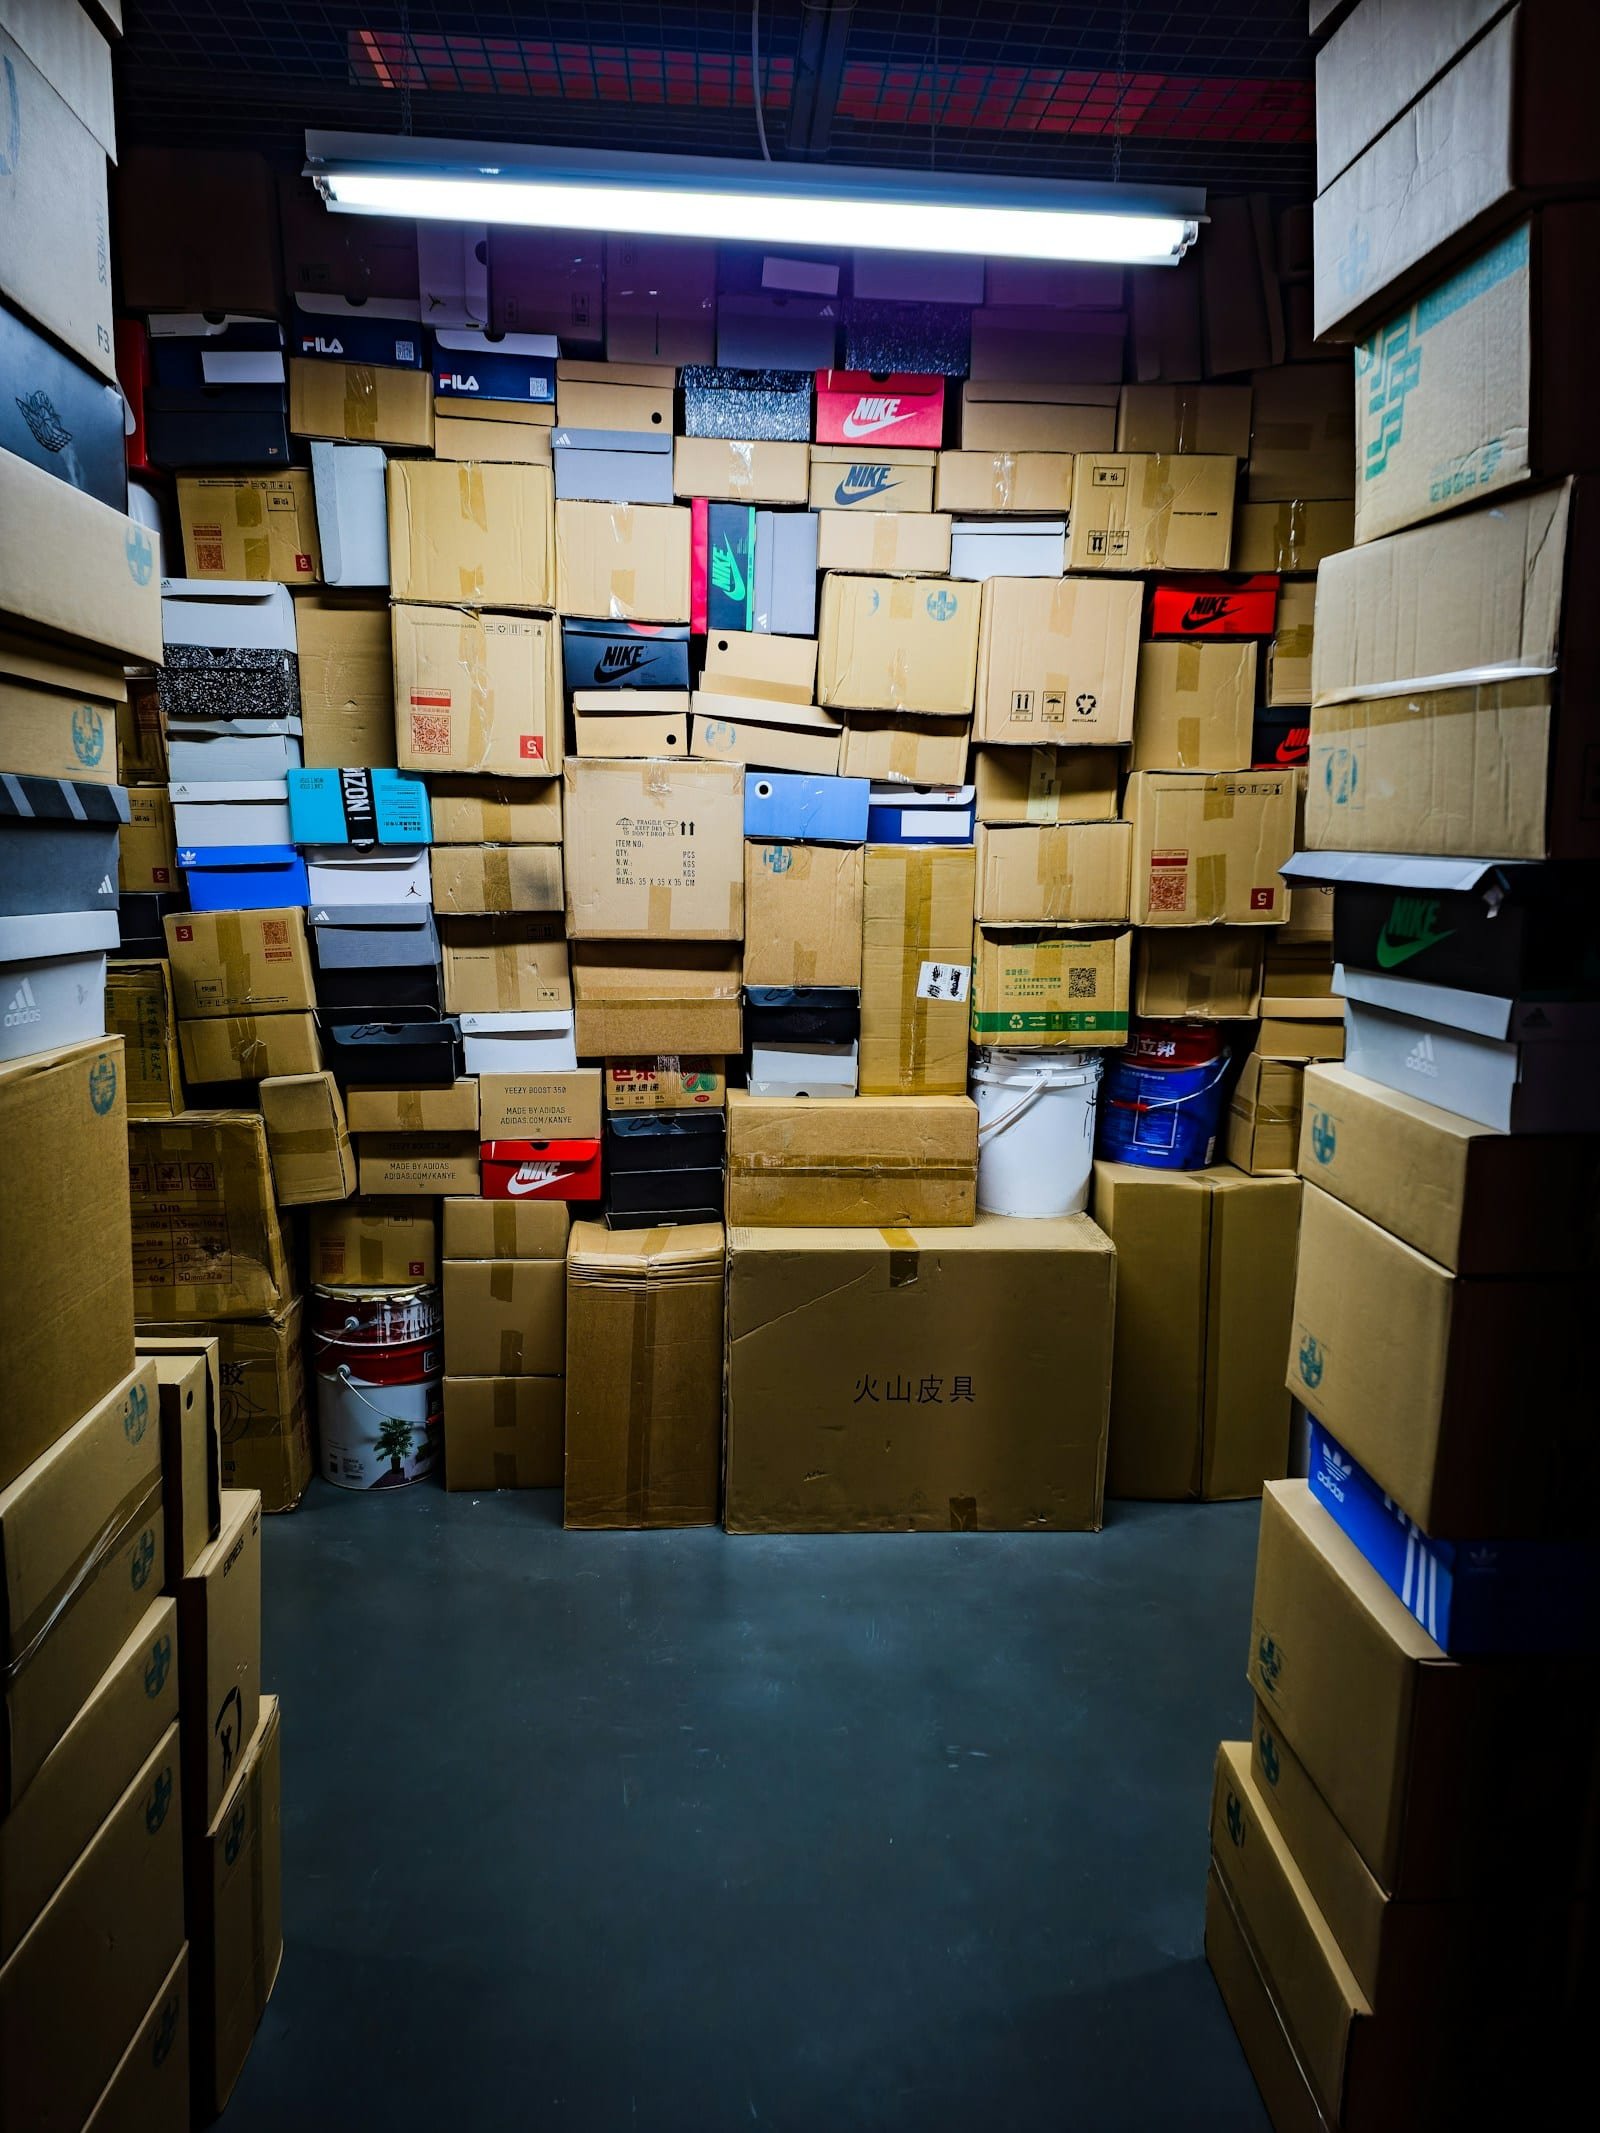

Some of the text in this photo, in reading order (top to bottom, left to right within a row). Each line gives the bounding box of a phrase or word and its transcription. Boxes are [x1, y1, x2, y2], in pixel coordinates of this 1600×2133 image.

[302, 336, 344, 354] FILA
[439, 373, 480, 391] FILA
[853, 397, 901, 421] NIKE
[845, 465, 891, 487] NIKE
[712, 544, 731, 592] NIKE
[1189, 596, 1231, 615] NIKE
[602, 646, 645, 667] NIKE
[526, 740, 538, 754] 5
[682, 860, 696, 868] KGS
[682, 869, 696, 877] KGS
[157, 870, 166, 881] 3
[674, 878, 682, 886] 35
[1257, 892, 1267, 905] 5
[1388, 896, 1440, 937] NIKE
[180, 929, 189, 939] 3
[3, 1008, 41, 1028] adidas
[1139, 1038, 1176, 1057] 立邦
[1405, 1055, 1439, 1078] adidas
[504, 1086, 567, 1095] YEEZY BOOST 350
[506, 1107, 527, 1115] MADE
[538, 1106, 566, 1114] ADIDAS
[500, 1116, 573, 1125] ADIDAS.COM/KANYE
[384, 1172, 457, 1180] ADIDAS.COM/KANYE
[516, 1162, 561, 1180] NIKE
[412, 1264, 421, 1273] 3
[853, 1374, 976, 1404] 火山皮具
[1317, 1471, 1344, 1504] adidas
